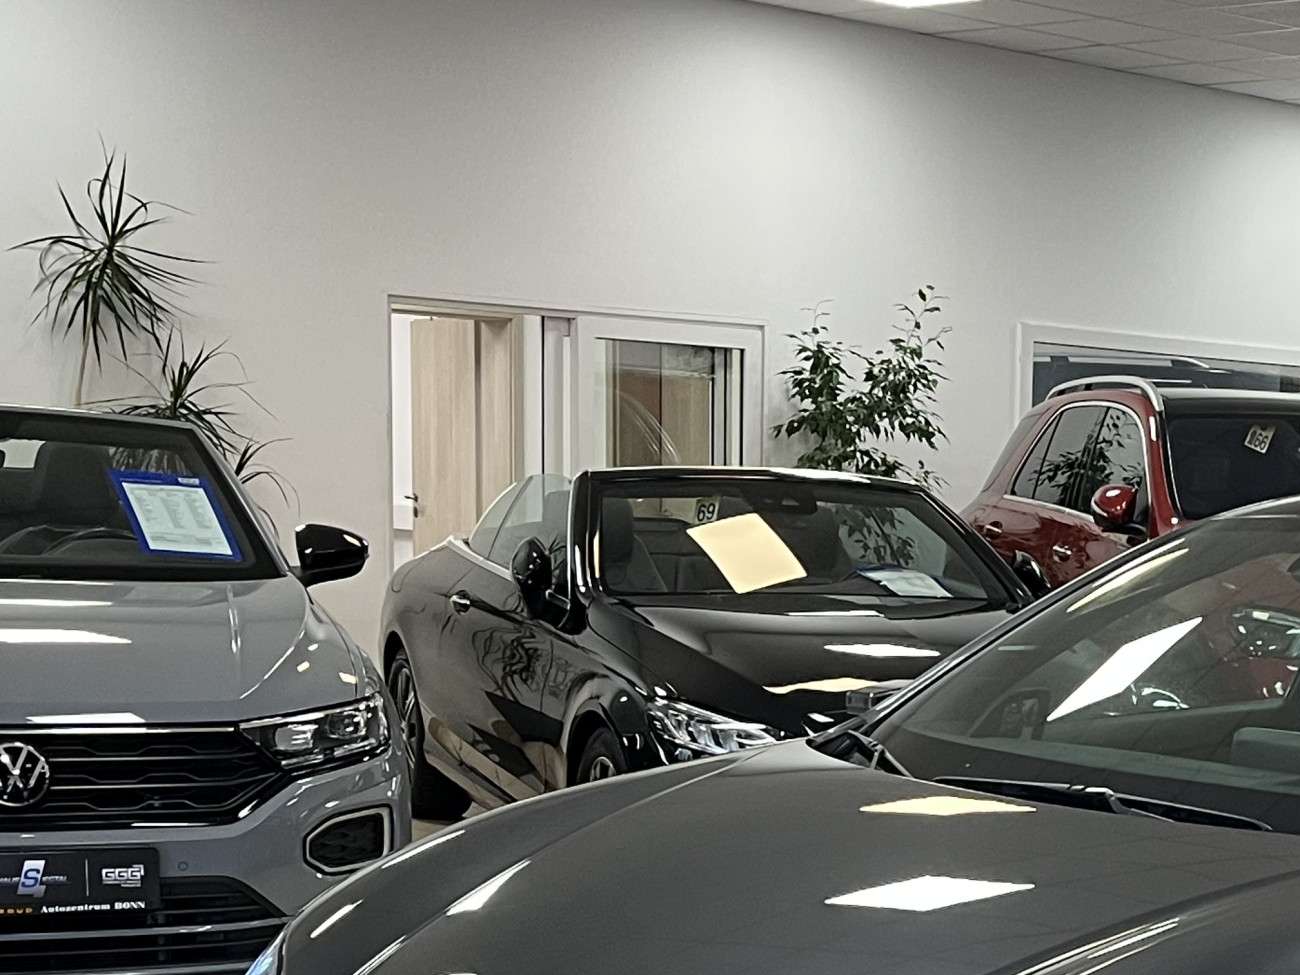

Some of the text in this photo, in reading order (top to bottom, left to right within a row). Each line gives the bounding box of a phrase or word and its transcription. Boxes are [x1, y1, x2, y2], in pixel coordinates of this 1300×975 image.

[697, 502, 716, 521] 69
[101, 867, 142, 881] GGG
[40, 902, 111, 914] Autozentrum
[114, 901, 146, 910] BONN
